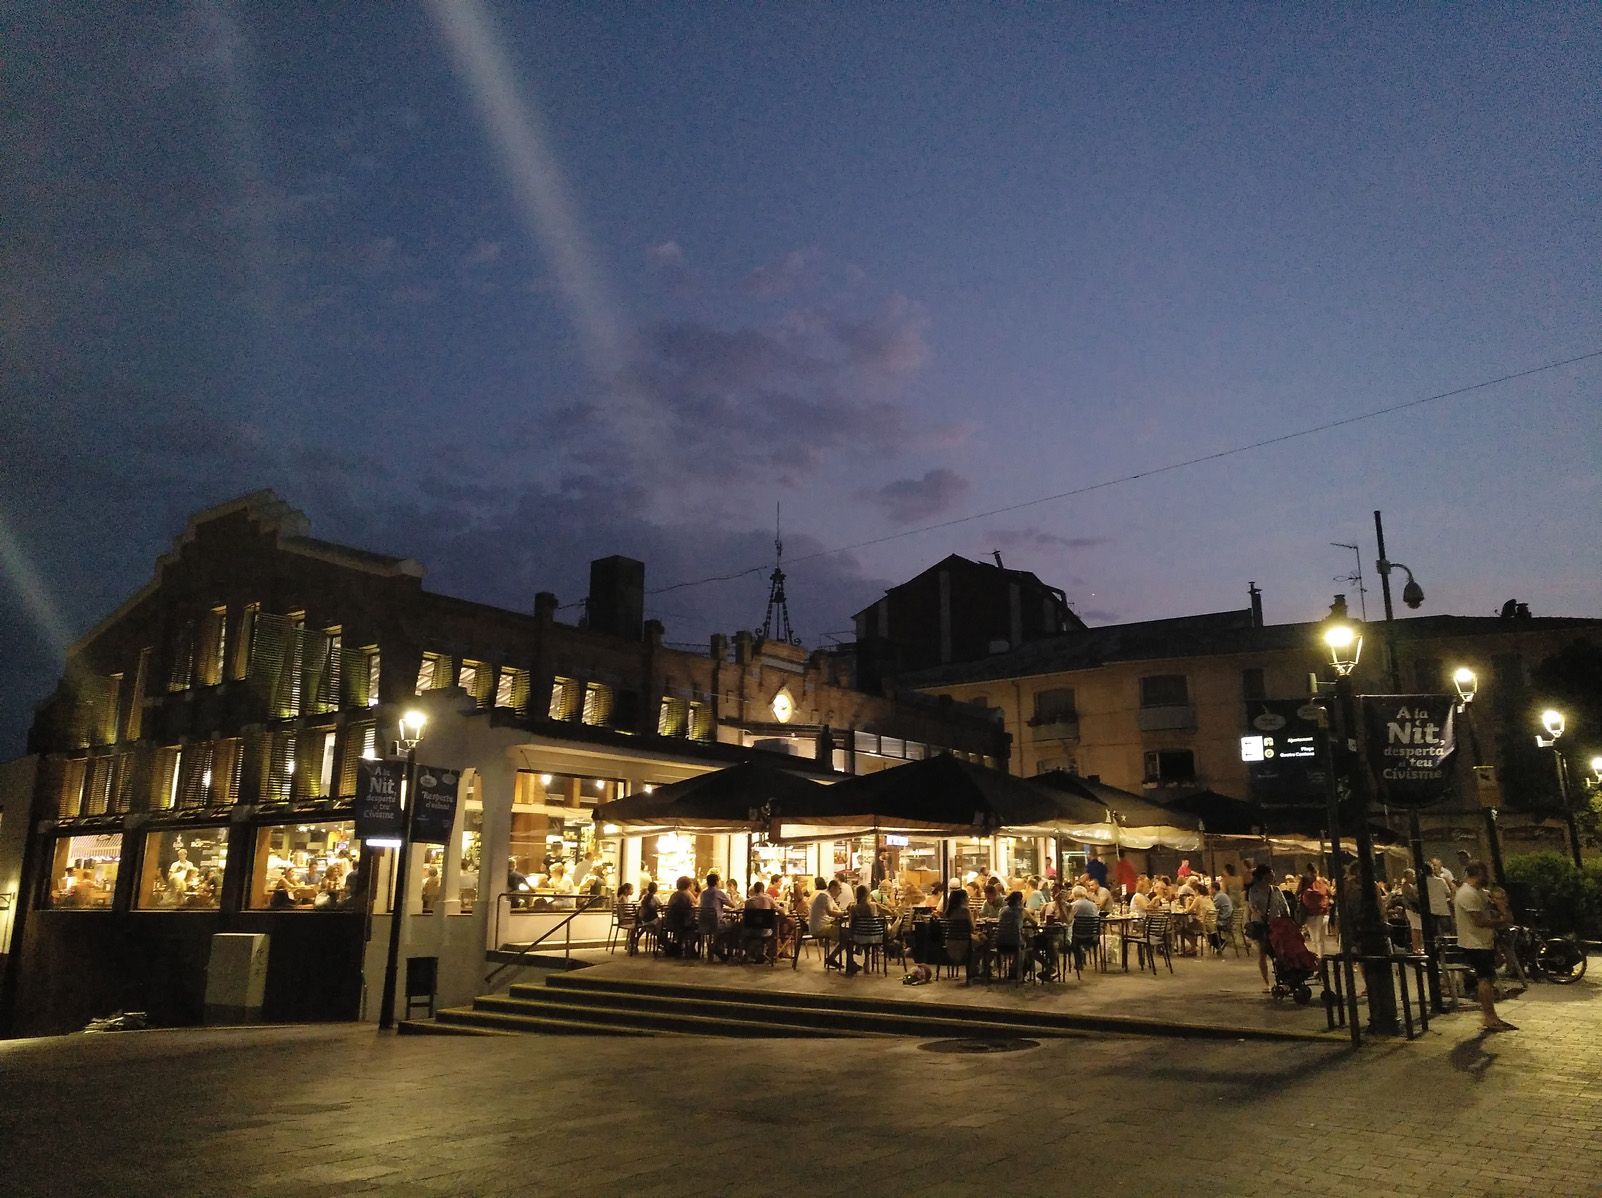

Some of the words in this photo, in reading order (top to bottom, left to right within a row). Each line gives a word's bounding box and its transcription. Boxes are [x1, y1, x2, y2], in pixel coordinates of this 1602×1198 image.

[1396, 706, 1411, 719] A
[1414, 708, 1428, 719] la
[1387, 720, 1446, 746] Nit,
[1384, 746, 1444, 759] desperta
[1410, 758, 1433, 767] teu
[1383, 767, 1442, 779] Civisme
